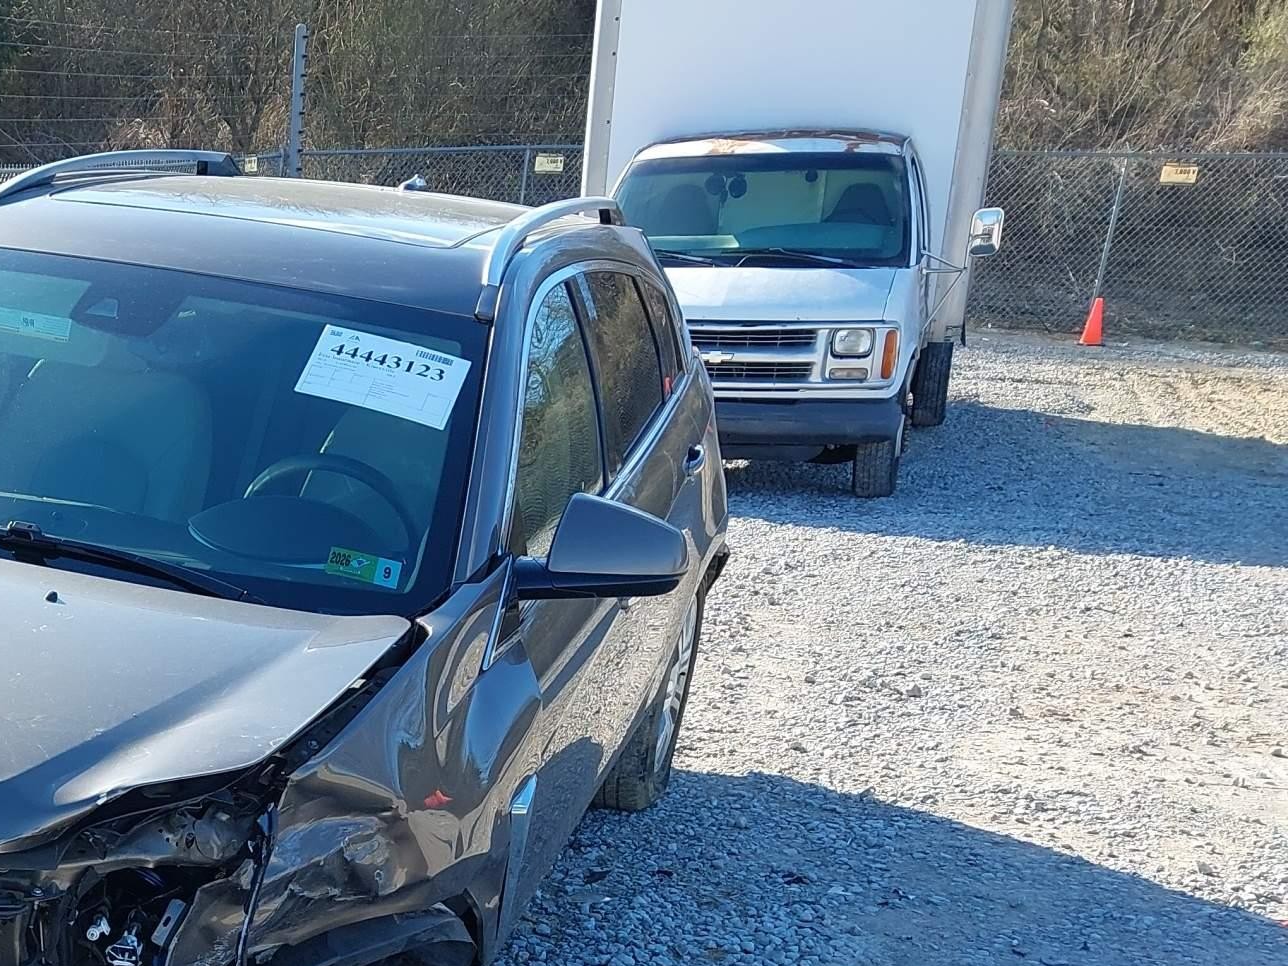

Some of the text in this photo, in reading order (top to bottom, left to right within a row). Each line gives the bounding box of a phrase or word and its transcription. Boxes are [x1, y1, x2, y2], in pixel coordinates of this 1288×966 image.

[330, 343, 446, 382] 44443123
[330, 551, 352, 567] 2026
[383, 566, 392, 580] 9
